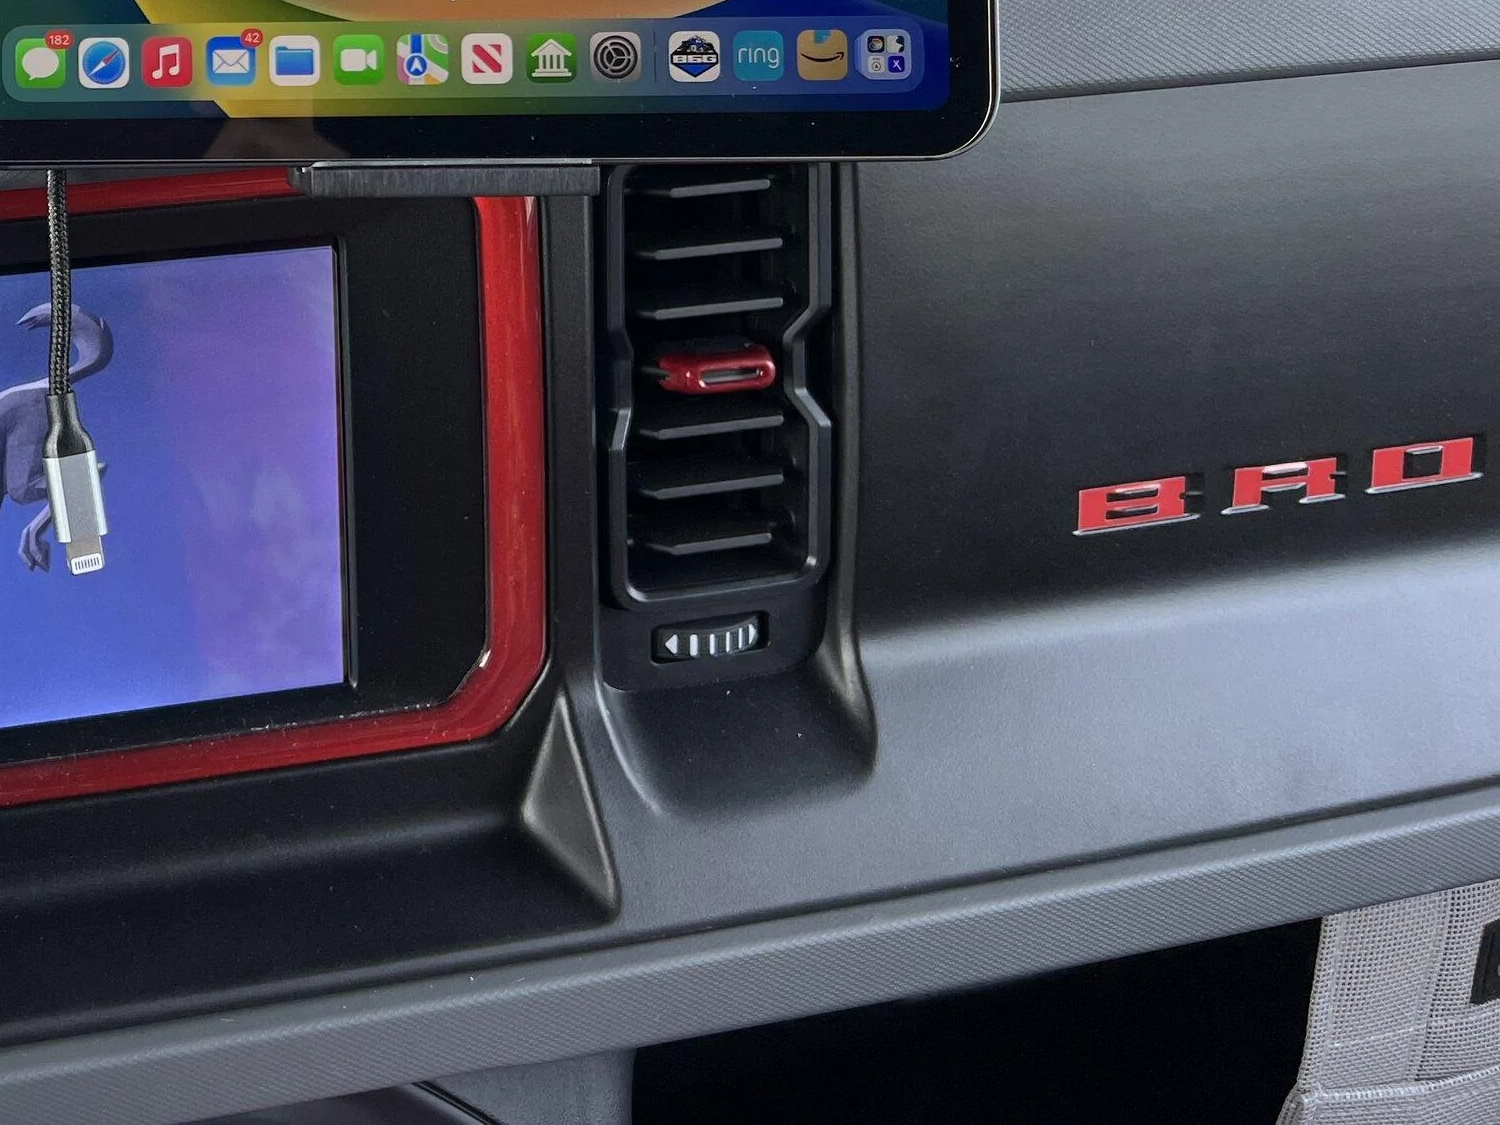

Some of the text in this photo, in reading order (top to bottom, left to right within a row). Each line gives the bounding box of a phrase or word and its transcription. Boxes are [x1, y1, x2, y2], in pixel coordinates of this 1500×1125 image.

[47, 34, 70, 45] 182
[244, 32, 260, 44] 42
[738, 46, 780, 69] ring
[1074, 436, 1481, 535] BRO
